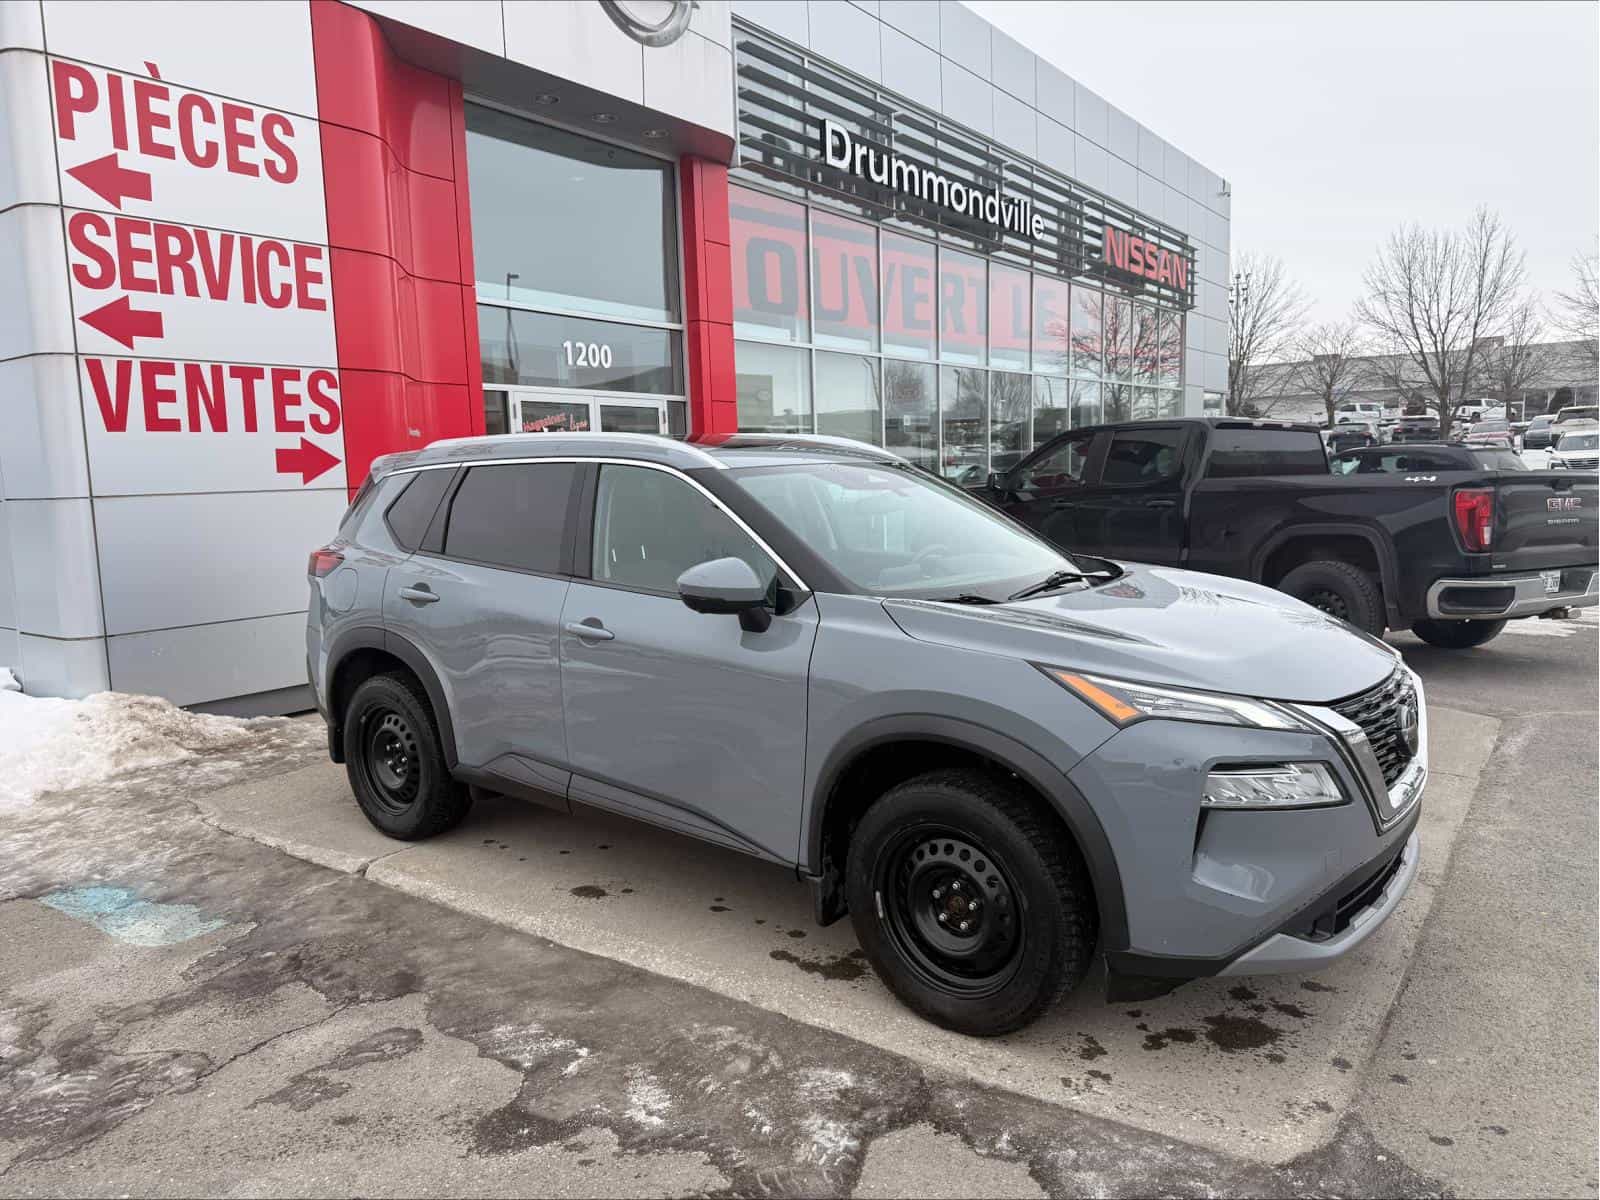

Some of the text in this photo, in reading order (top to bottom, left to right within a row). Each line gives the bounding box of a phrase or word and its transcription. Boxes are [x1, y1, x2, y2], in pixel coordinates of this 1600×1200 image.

[52, 60, 299, 184] PIÈCES
[822, 118, 1046, 241] Drummondville
[68, 212, 327, 312] SERVICE
[745, 237, 996, 336] OUVERT
[1103, 226, 1188, 290] NISSAN
[84, 357, 342, 435] VENTES
[562, 340, 613, 369] 1200
[1546, 497, 1583, 512] GMC
